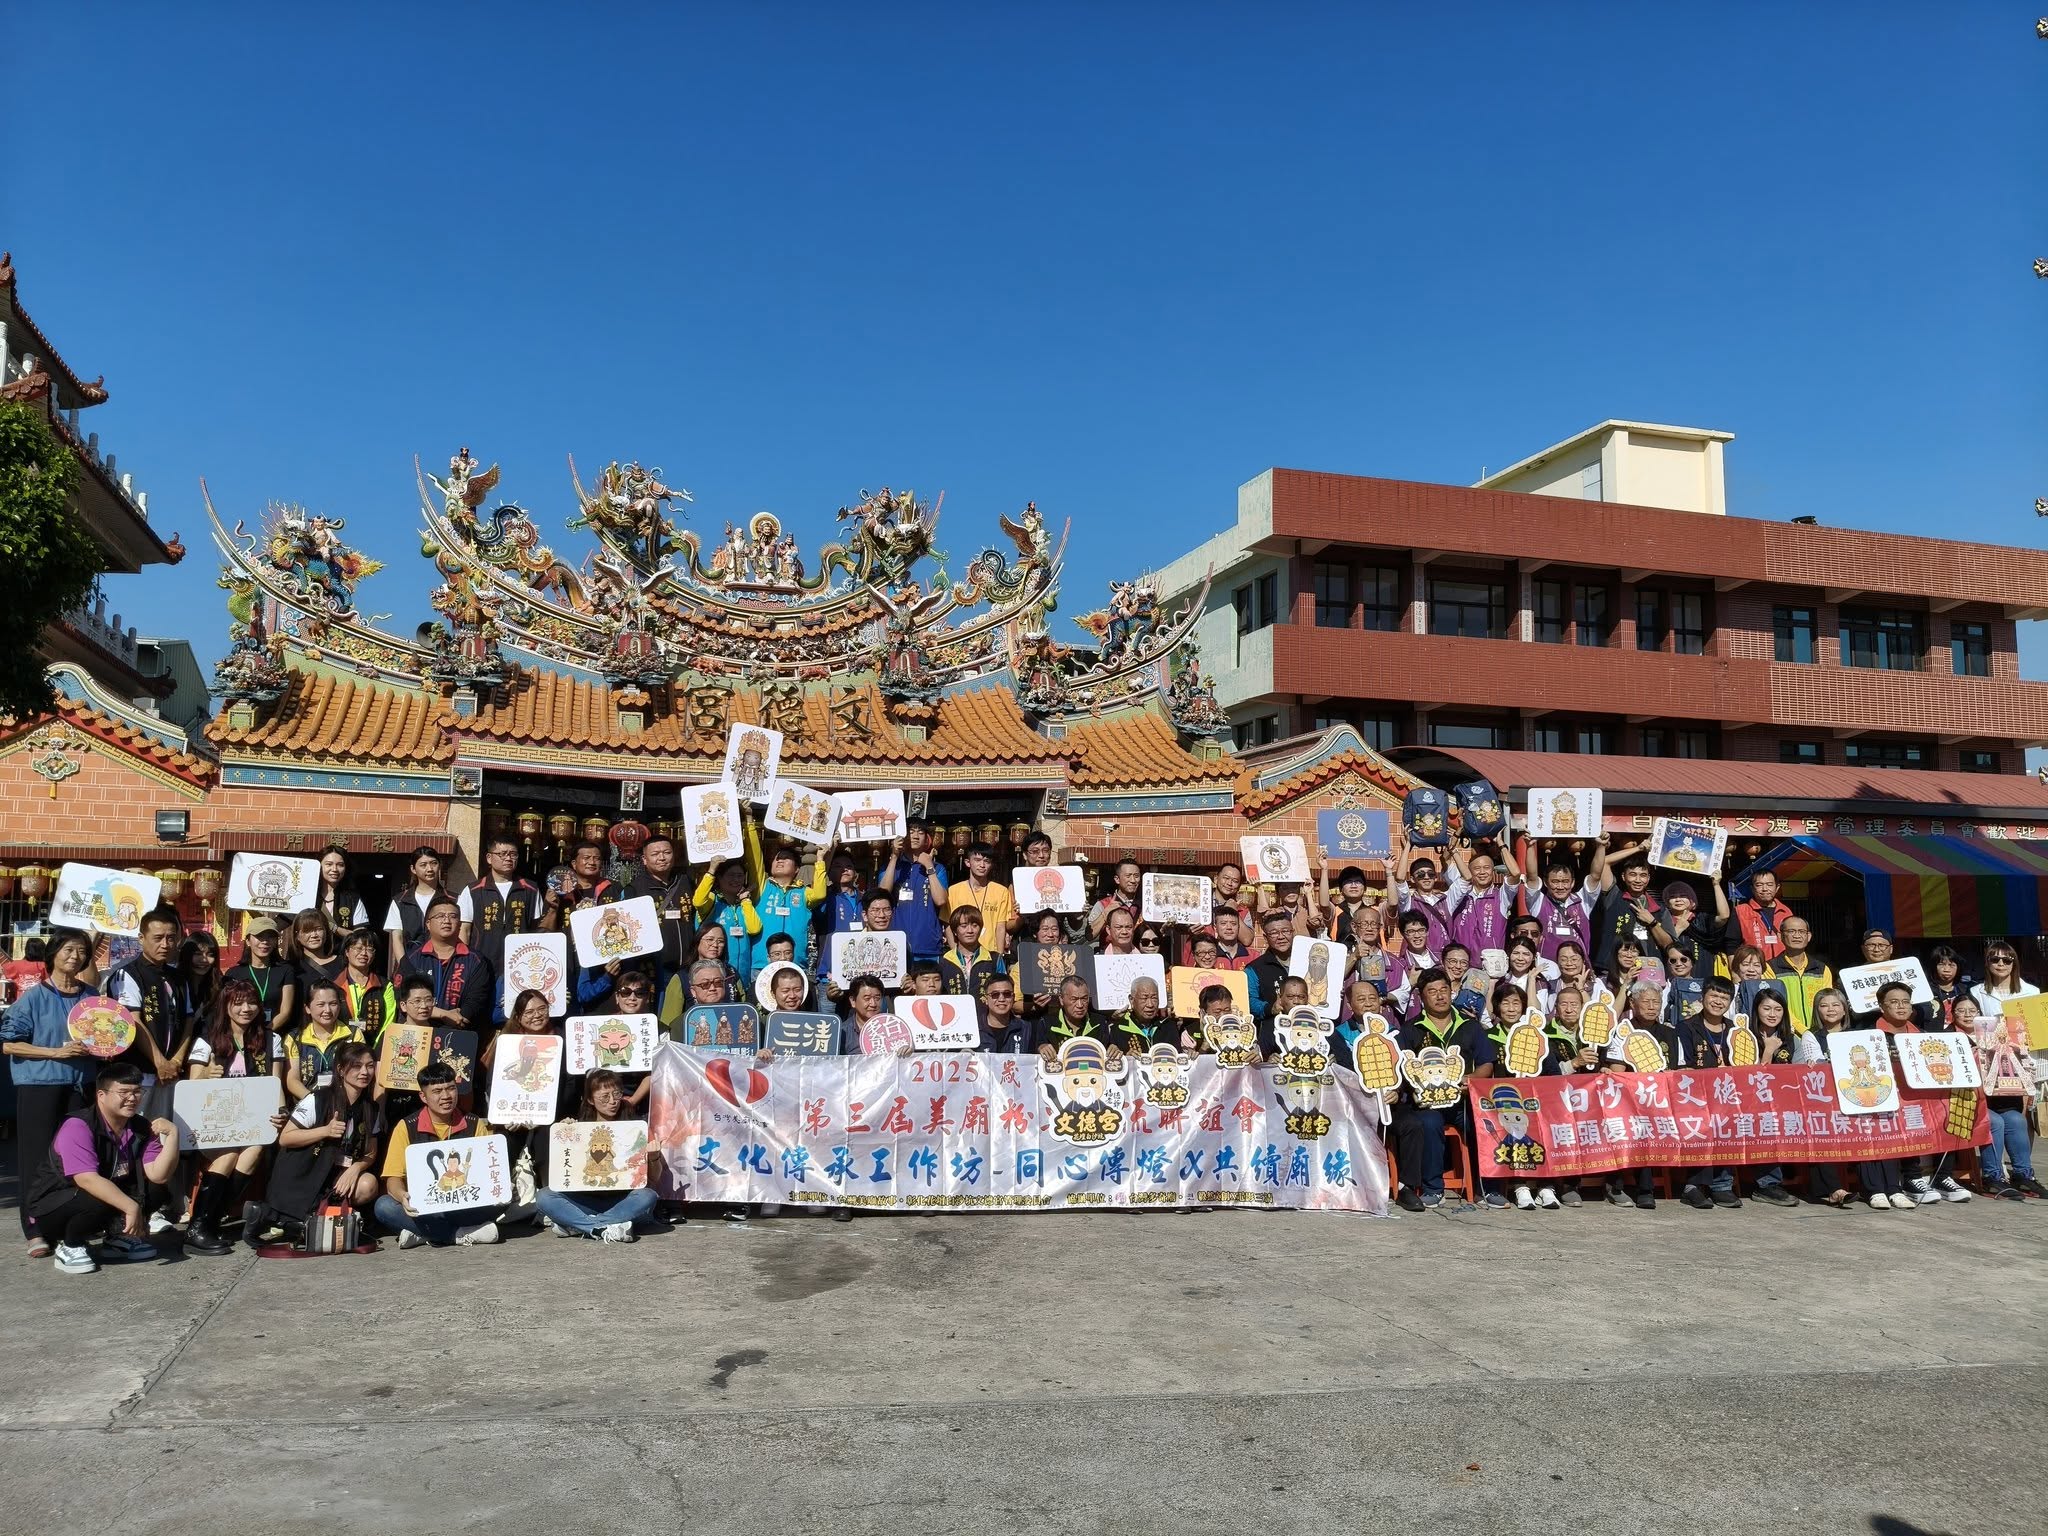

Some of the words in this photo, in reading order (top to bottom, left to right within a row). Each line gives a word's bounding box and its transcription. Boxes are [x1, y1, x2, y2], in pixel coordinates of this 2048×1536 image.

[574, 1021, 586, 1069] 關聖帝君
[773, 1019, 832, 1053] 三清
[911, 1060, 980, 1083] 2025
[1283, 1052, 1328, 1070] 文德宮
[1147, 1087, 1187, 1101] 文德宮
[1422, 1087, 1459, 1102] 文德宮
[803, 1096, 1266, 1136] 第三屆美廟粉流聯誼會
[1056, 1111, 1121, 1134] 文德宮
[1286, 1113, 1330, 1135] 文德宮
[1496, 1142, 1545, 1163] 文德宮
[487, 1141, 503, 1198] 天上聖母
[563, 1147, 573, 1188] 玄天上帝
